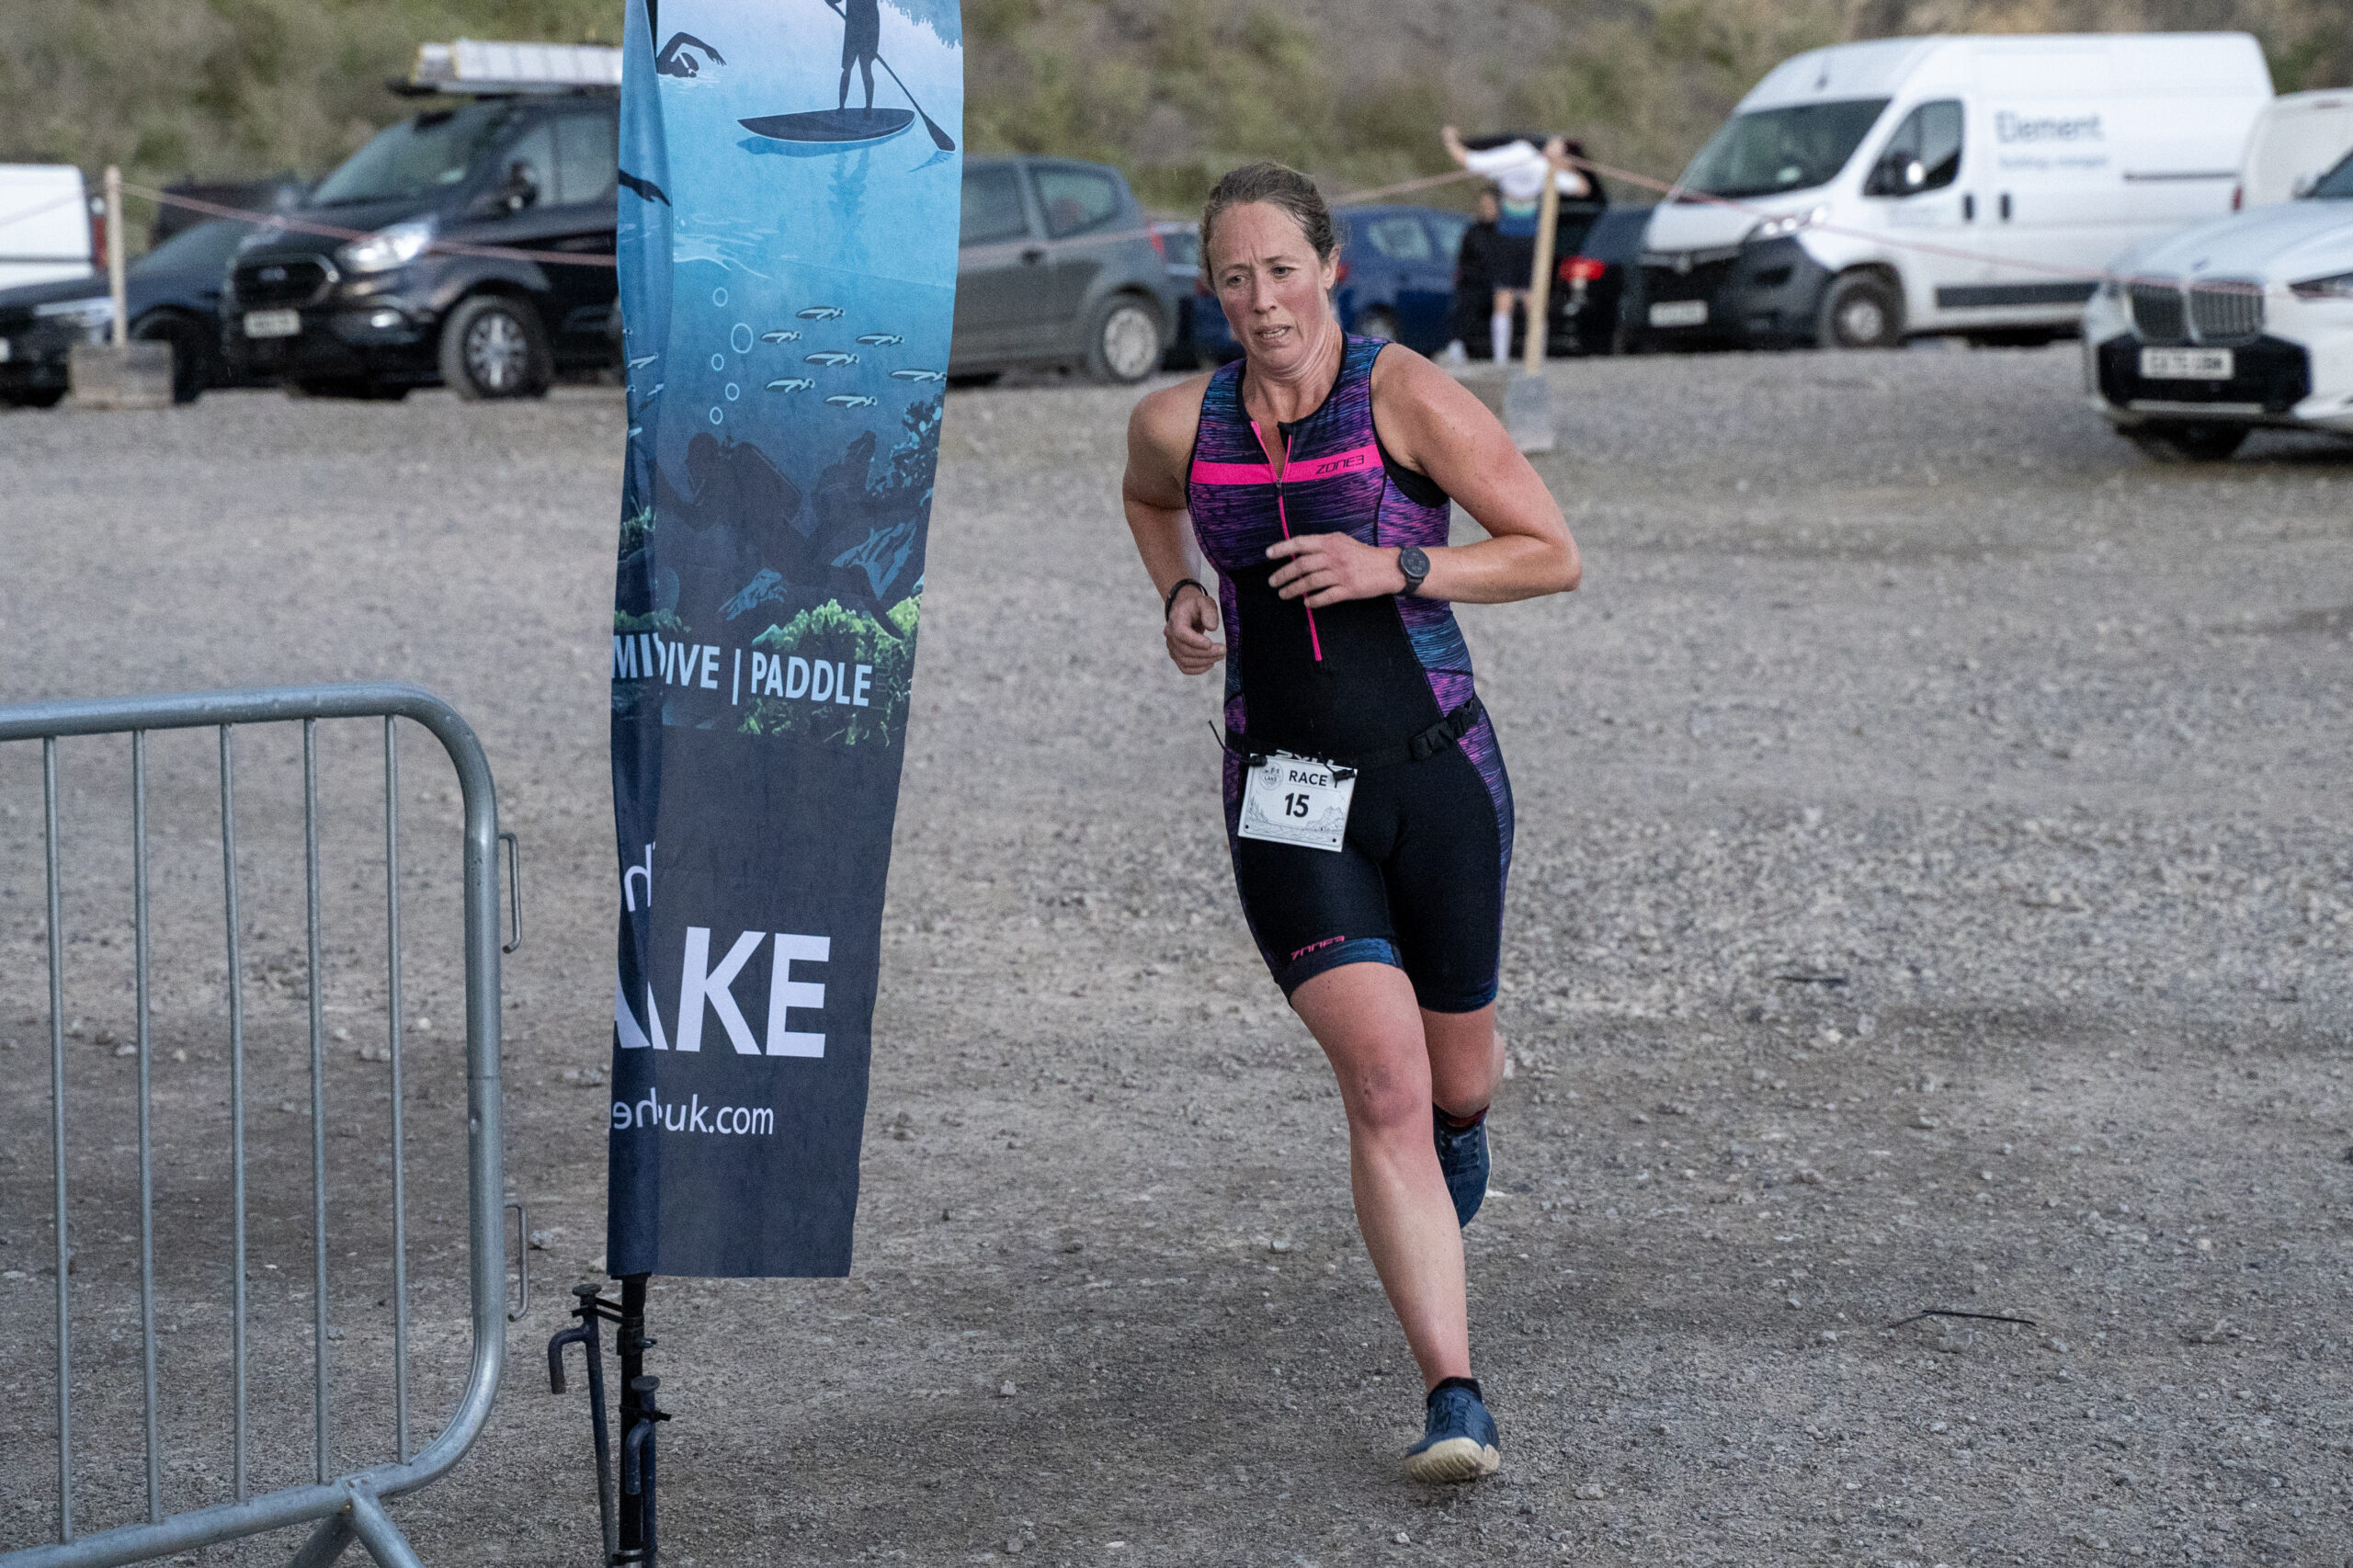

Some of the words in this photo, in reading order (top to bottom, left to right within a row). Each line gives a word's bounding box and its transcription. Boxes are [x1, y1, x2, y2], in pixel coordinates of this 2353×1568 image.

[751, 651, 873, 707] PADDLE
[1289, 769, 1328, 787] RACE
[1284, 792, 1310, 818] 15
